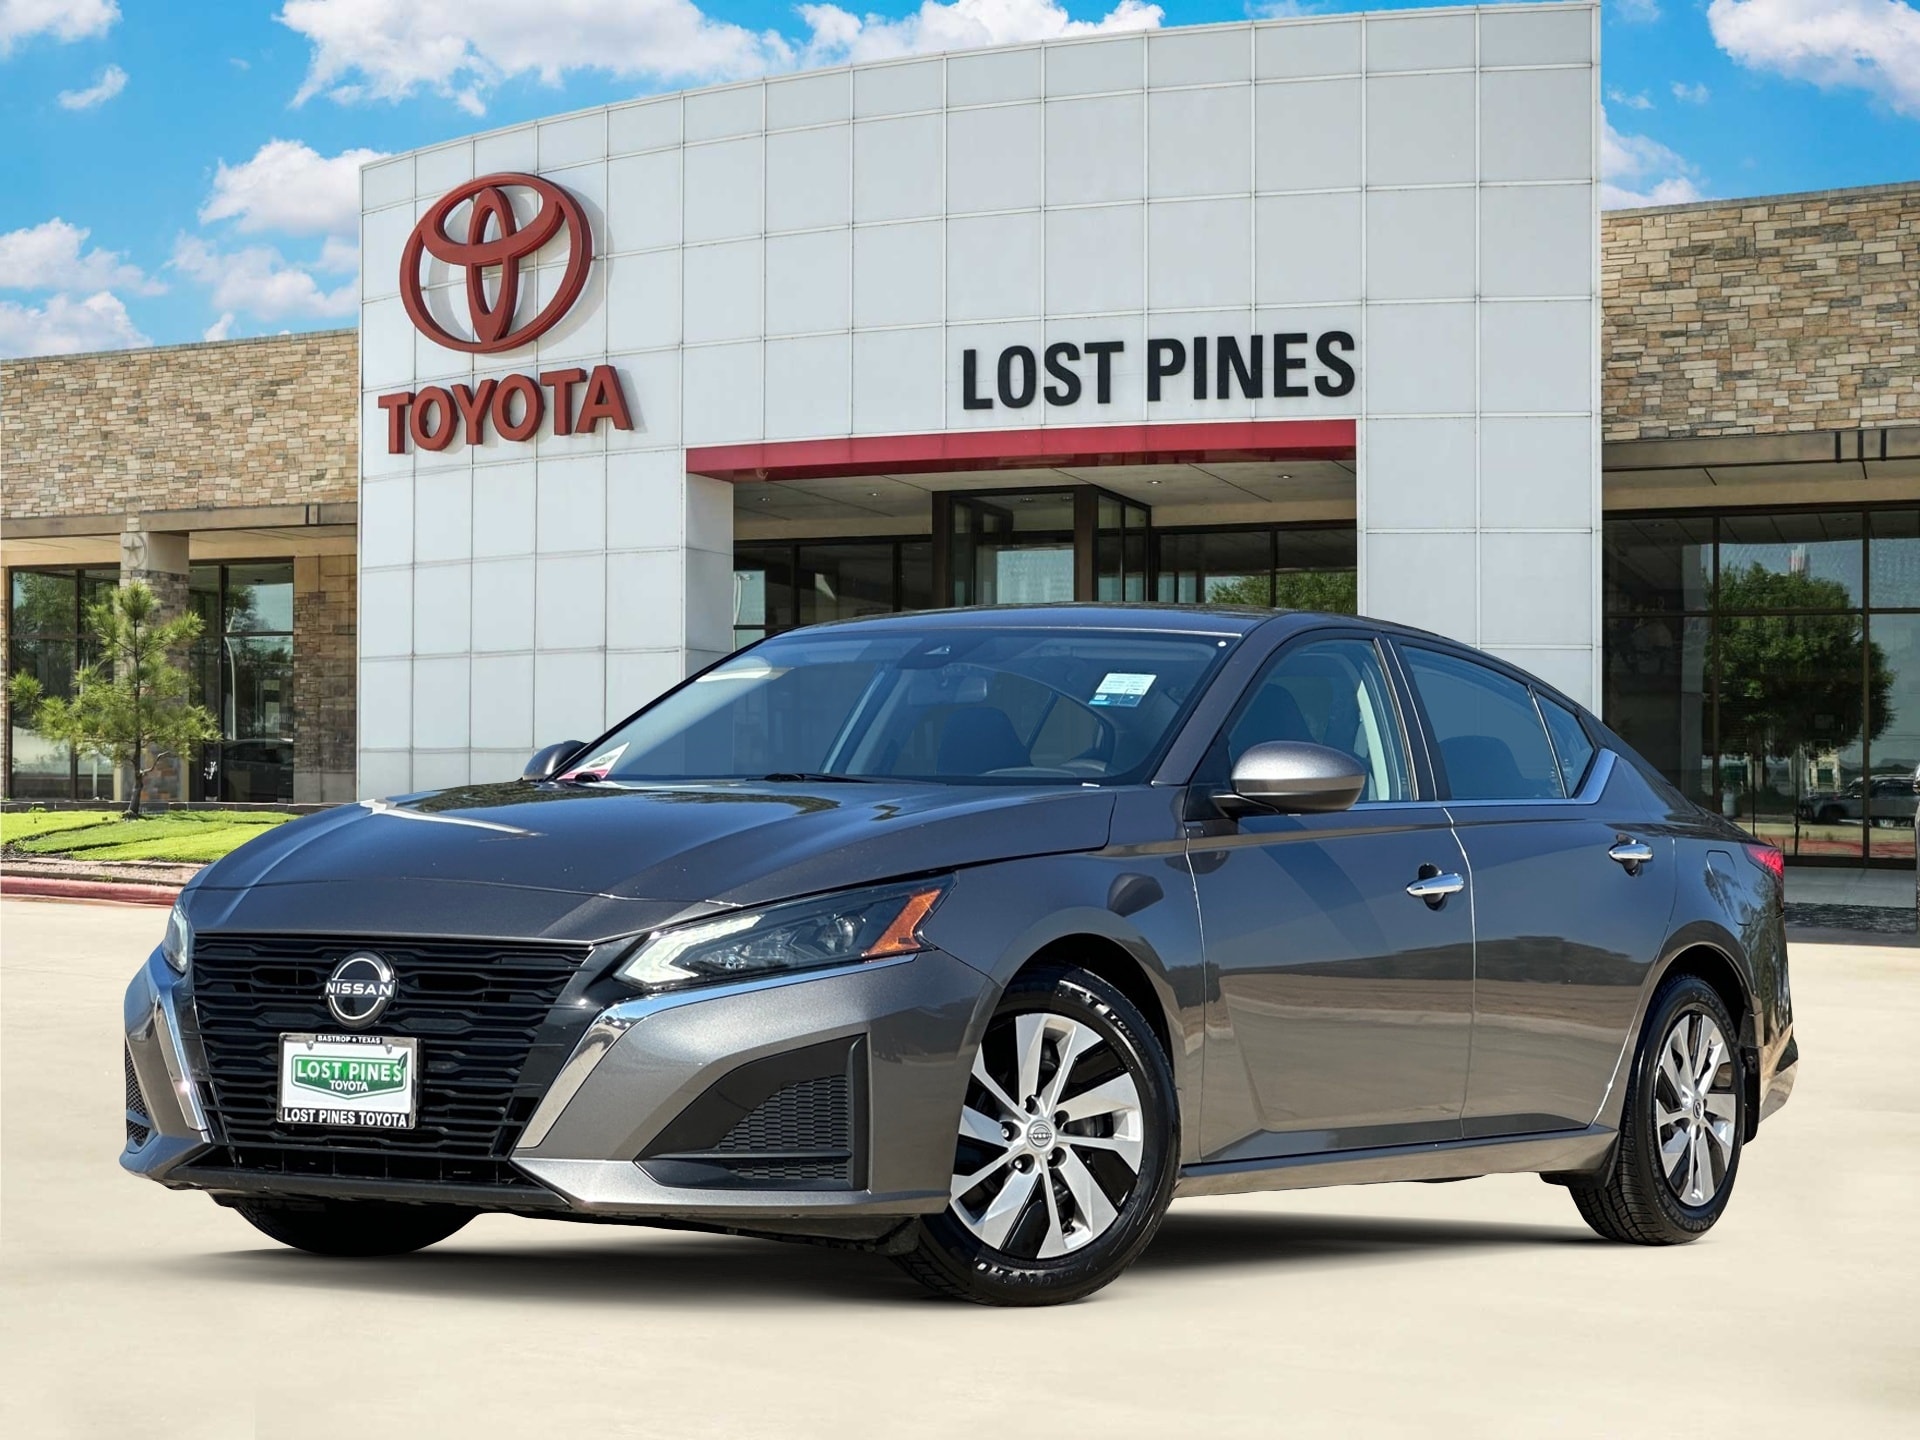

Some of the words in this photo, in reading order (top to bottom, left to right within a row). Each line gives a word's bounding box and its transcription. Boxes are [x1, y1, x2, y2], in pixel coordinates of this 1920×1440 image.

[963, 341, 1124, 409] LOST
[1147, 330, 1356, 402] PINES
[378, 365, 634, 454] TOYOTA
[326, 982, 392, 995] NISSAN
[297, 1061, 342, 1078] LOST
[350, 1063, 401, 1081] PINES
[330, 1080, 369, 1091] TOYOTA
[284, 1108, 316, 1122] LOST
[319, 1110, 355, 1124] PINES
[360, 1112, 407, 1127] TOYOTA
